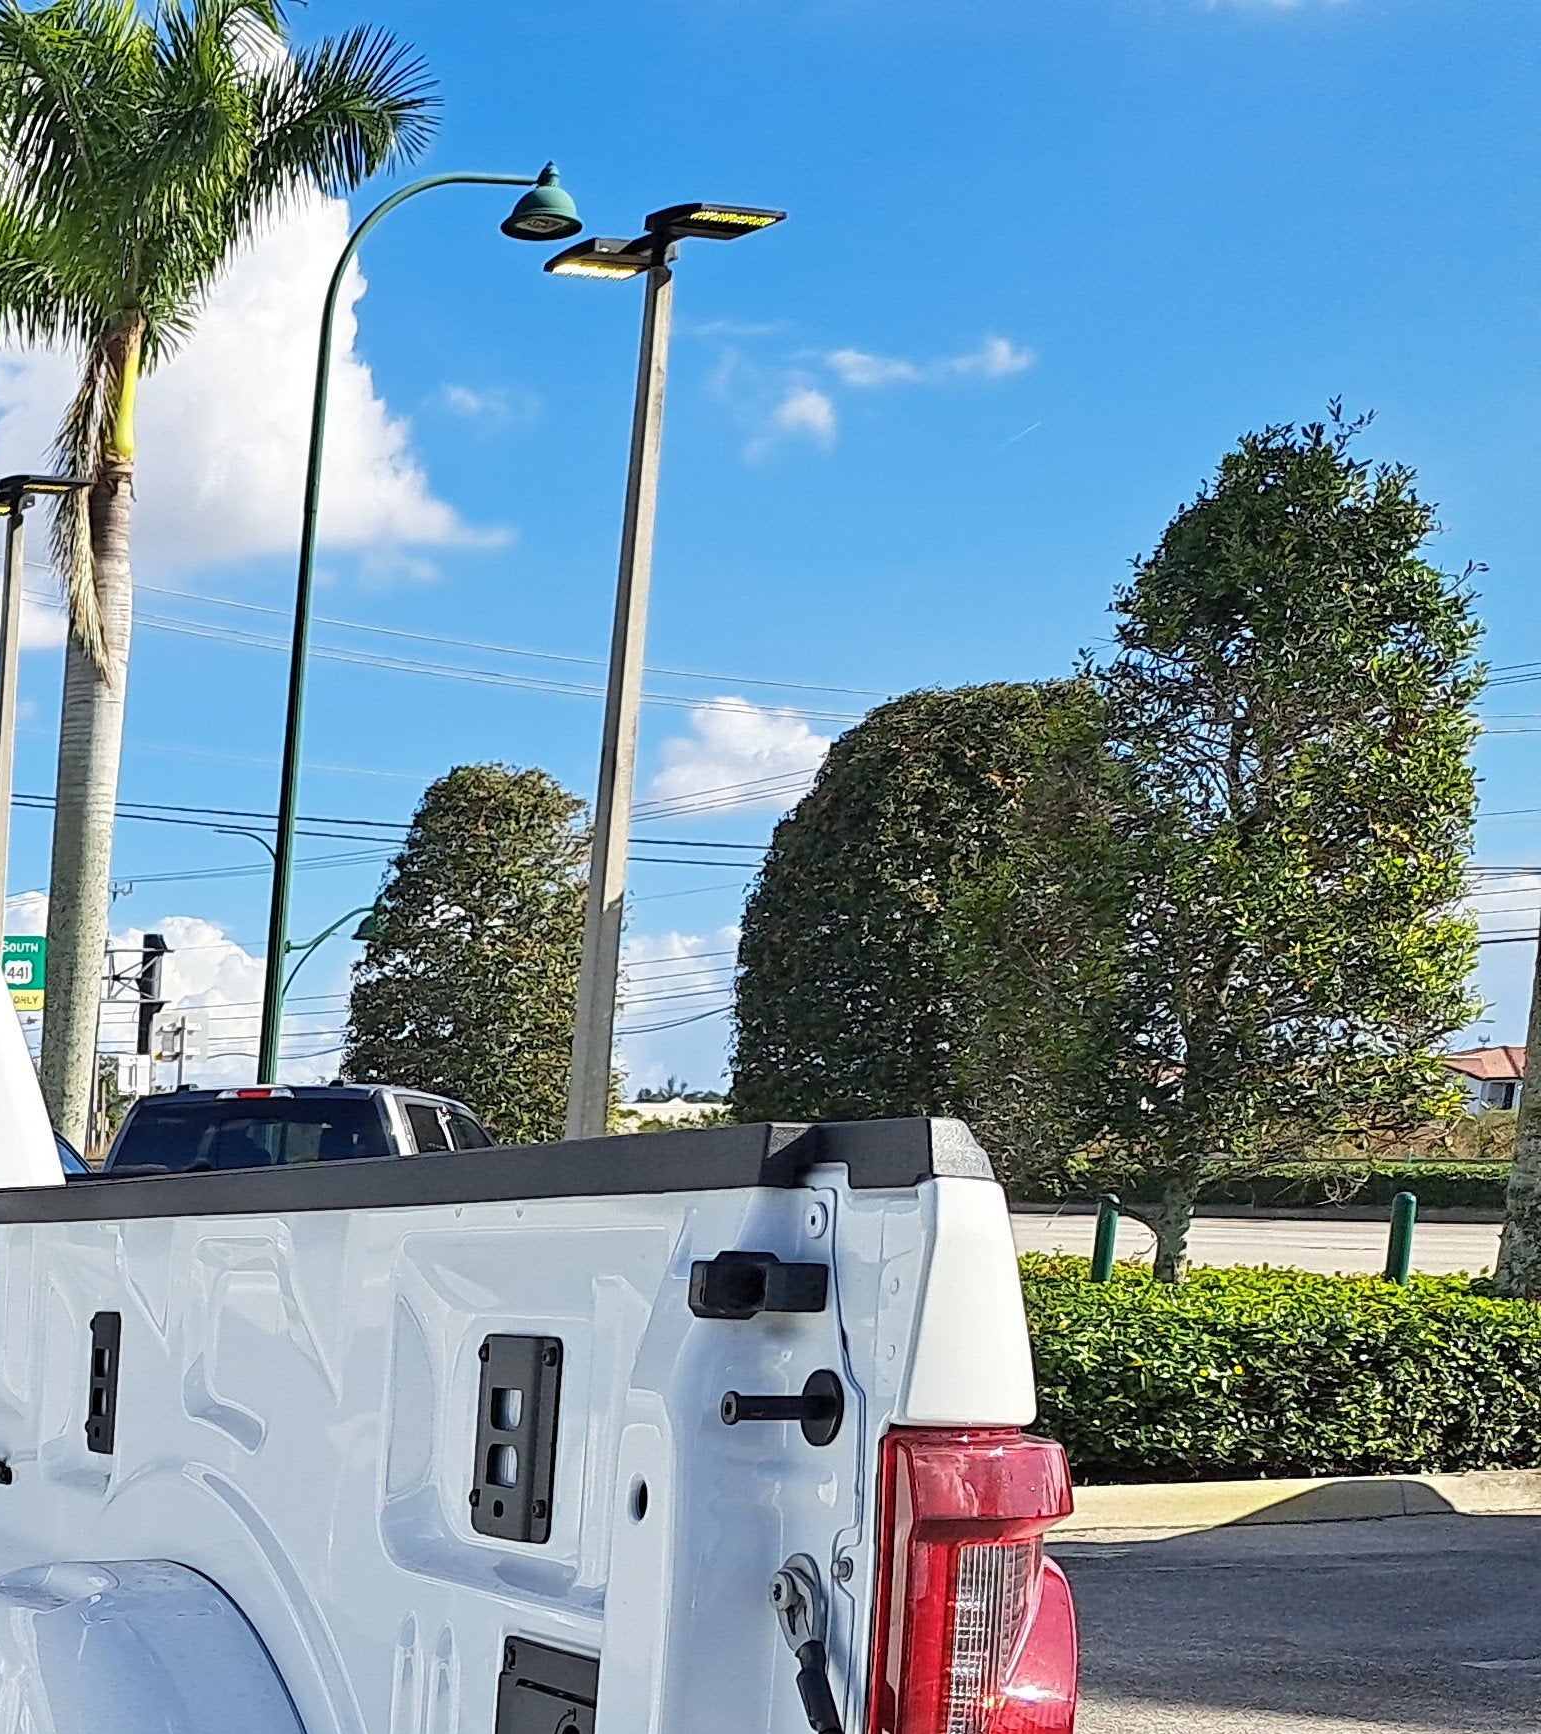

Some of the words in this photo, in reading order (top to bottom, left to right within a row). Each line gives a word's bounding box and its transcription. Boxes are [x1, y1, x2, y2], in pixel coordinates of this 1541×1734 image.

[2, 941, 38, 953] SOUTH
[7, 966, 29, 980] 441
[13, 995, 38, 1005] ONLY
